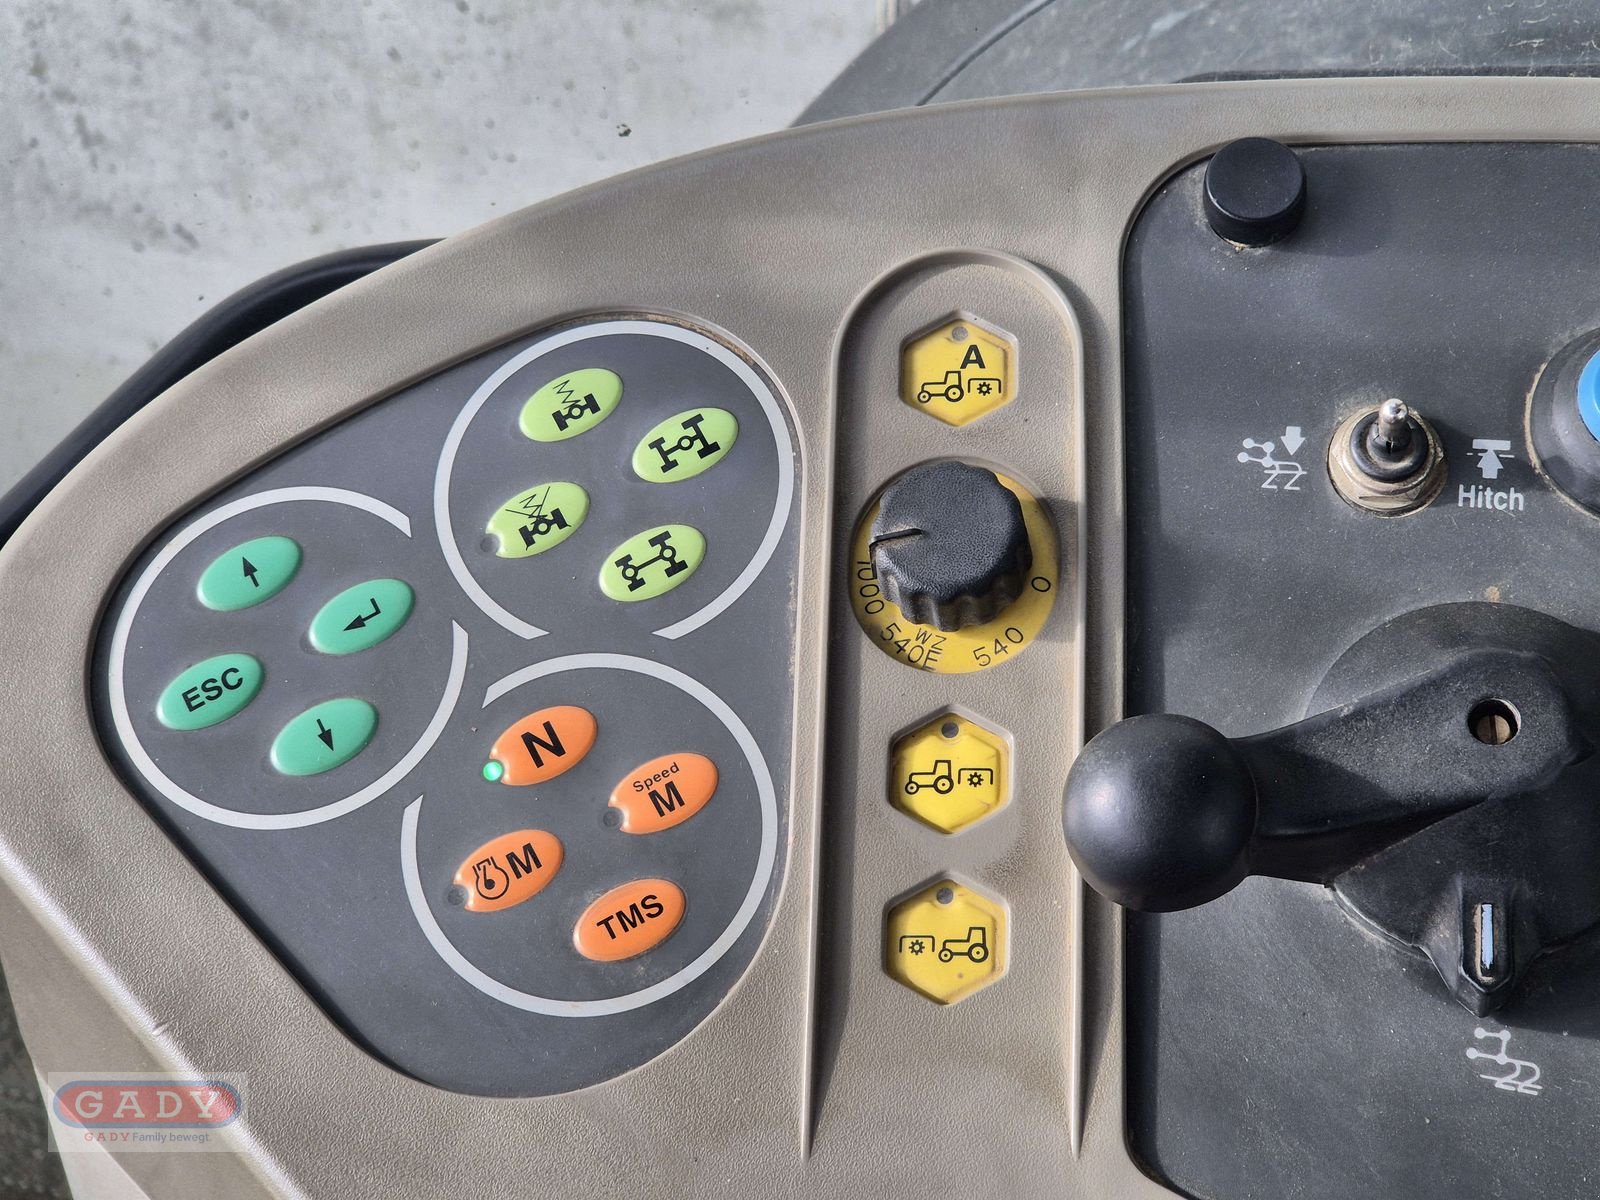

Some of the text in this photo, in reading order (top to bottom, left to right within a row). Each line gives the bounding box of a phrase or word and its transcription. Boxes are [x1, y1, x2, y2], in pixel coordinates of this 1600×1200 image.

[960, 344, 986, 369] A
[1457, 484, 1525, 511] Hitch
[1031, 576, 1051, 593] 0
[880, 622, 943, 672] 540E
[914, 627, 947, 651] WZ
[973, 627, 1024, 667] 540
[182, 667, 244, 713] ESC
[520, 720, 567, 769] N
[632, 762, 680, 793] Speed
[647, 780, 685, 818] M
[505, 842, 543, 880] M
[596, 894, 665, 940] TMS
